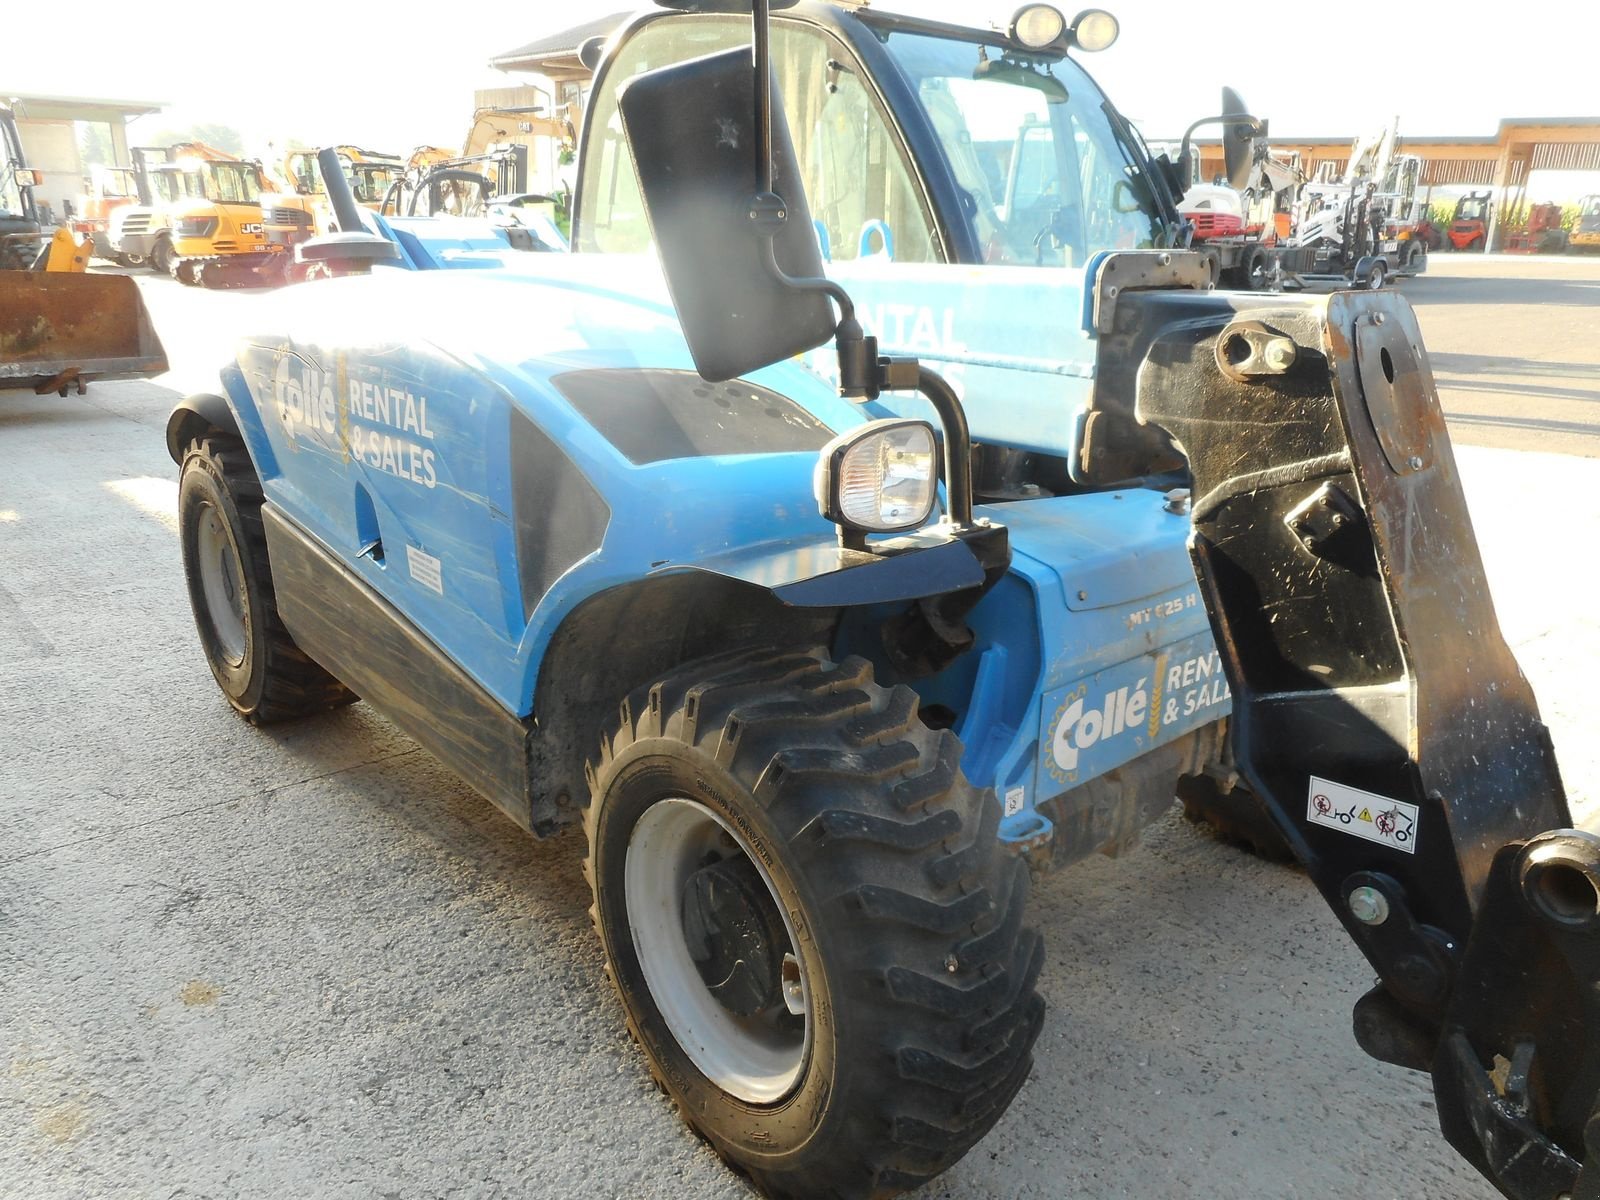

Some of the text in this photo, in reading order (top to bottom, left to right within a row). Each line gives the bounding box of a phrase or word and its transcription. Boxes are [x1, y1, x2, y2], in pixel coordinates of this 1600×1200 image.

[275, 357, 336, 439] Collé
[351, 379, 434, 439] RENTAL
[353, 425, 437, 489] & SALES
[1186, 593, 1196, 608] H
[1168, 650, 1224, 692] RENT
[1053, 677, 1147, 770] Collé
[1163, 679, 1232, 725] & SAL
